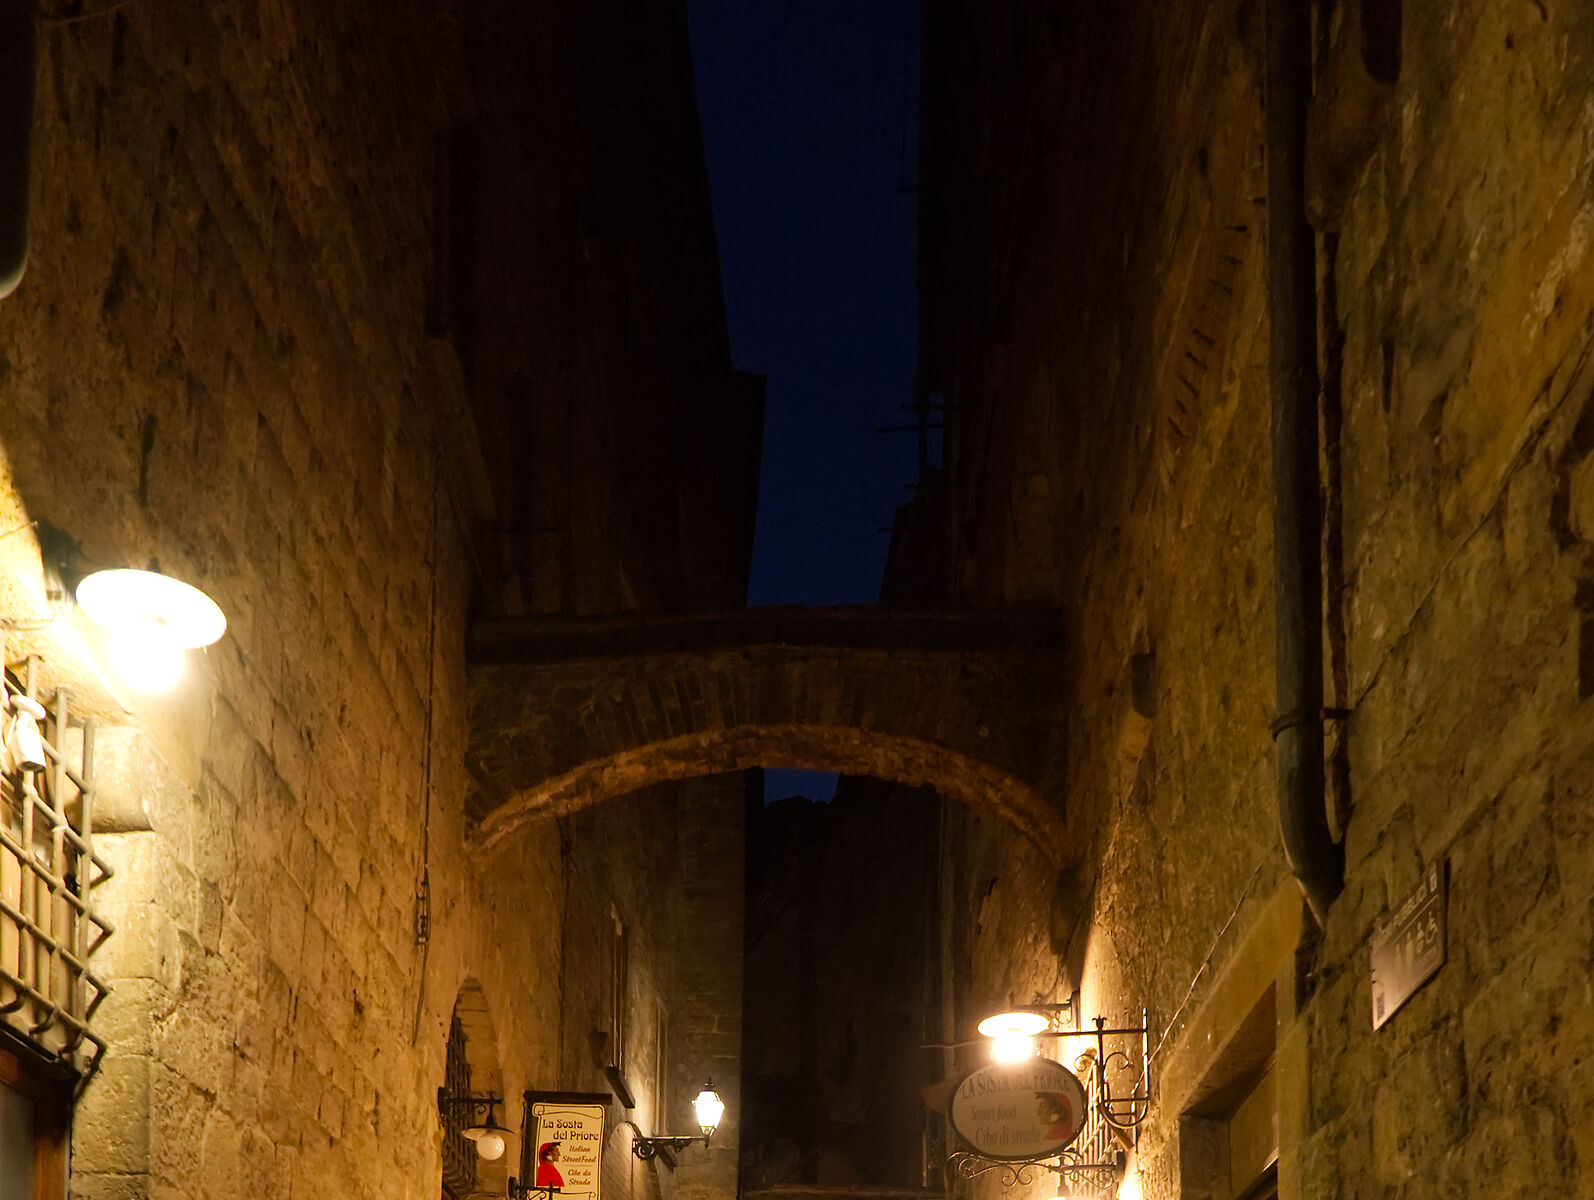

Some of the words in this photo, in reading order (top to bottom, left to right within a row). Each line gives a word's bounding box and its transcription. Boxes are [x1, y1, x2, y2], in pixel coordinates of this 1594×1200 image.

[542, 1119, 554, 1129] La
[556, 1119, 583, 1129] Sosta
[553, 1131, 568, 1140] del
[570, 1131, 599, 1141] Priore
[976, 1127, 998, 1146] Cibo
[568, 1178, 591, 1186] Strada
